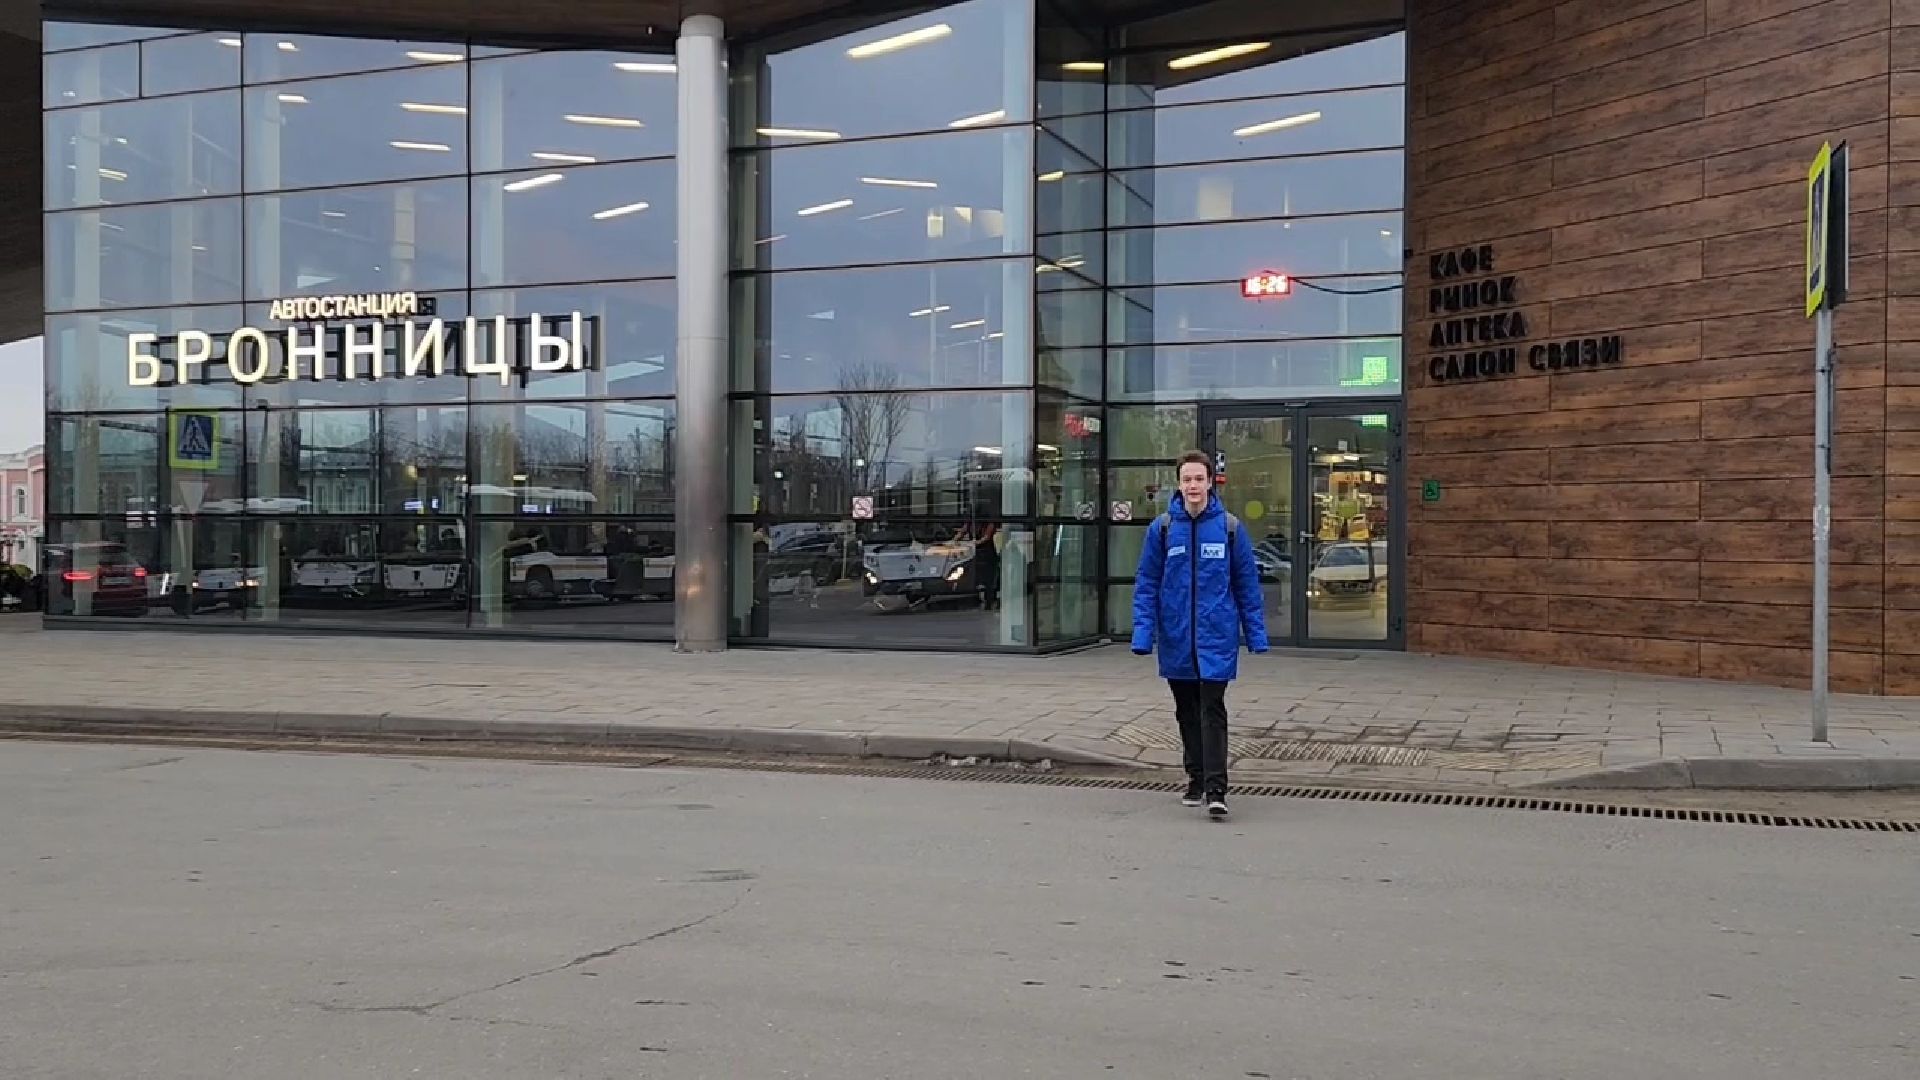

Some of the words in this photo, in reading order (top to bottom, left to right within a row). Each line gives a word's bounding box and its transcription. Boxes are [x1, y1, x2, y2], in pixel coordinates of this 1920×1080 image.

[1430, 246, 1492, 279] КАФЕ
[270, 292, 418, 319] АВТОСТАНЦИЯ
[1430, 276, 1516, 312] РЫНОК
[1430, 312, 1526, 346] АПТЕКА
[128, 311, 584, 386] БРОННИЦЫ
[1430, 348, 1516, 381] САЛОН
[1529, 335, 1622, 370] СВЯЗИ
